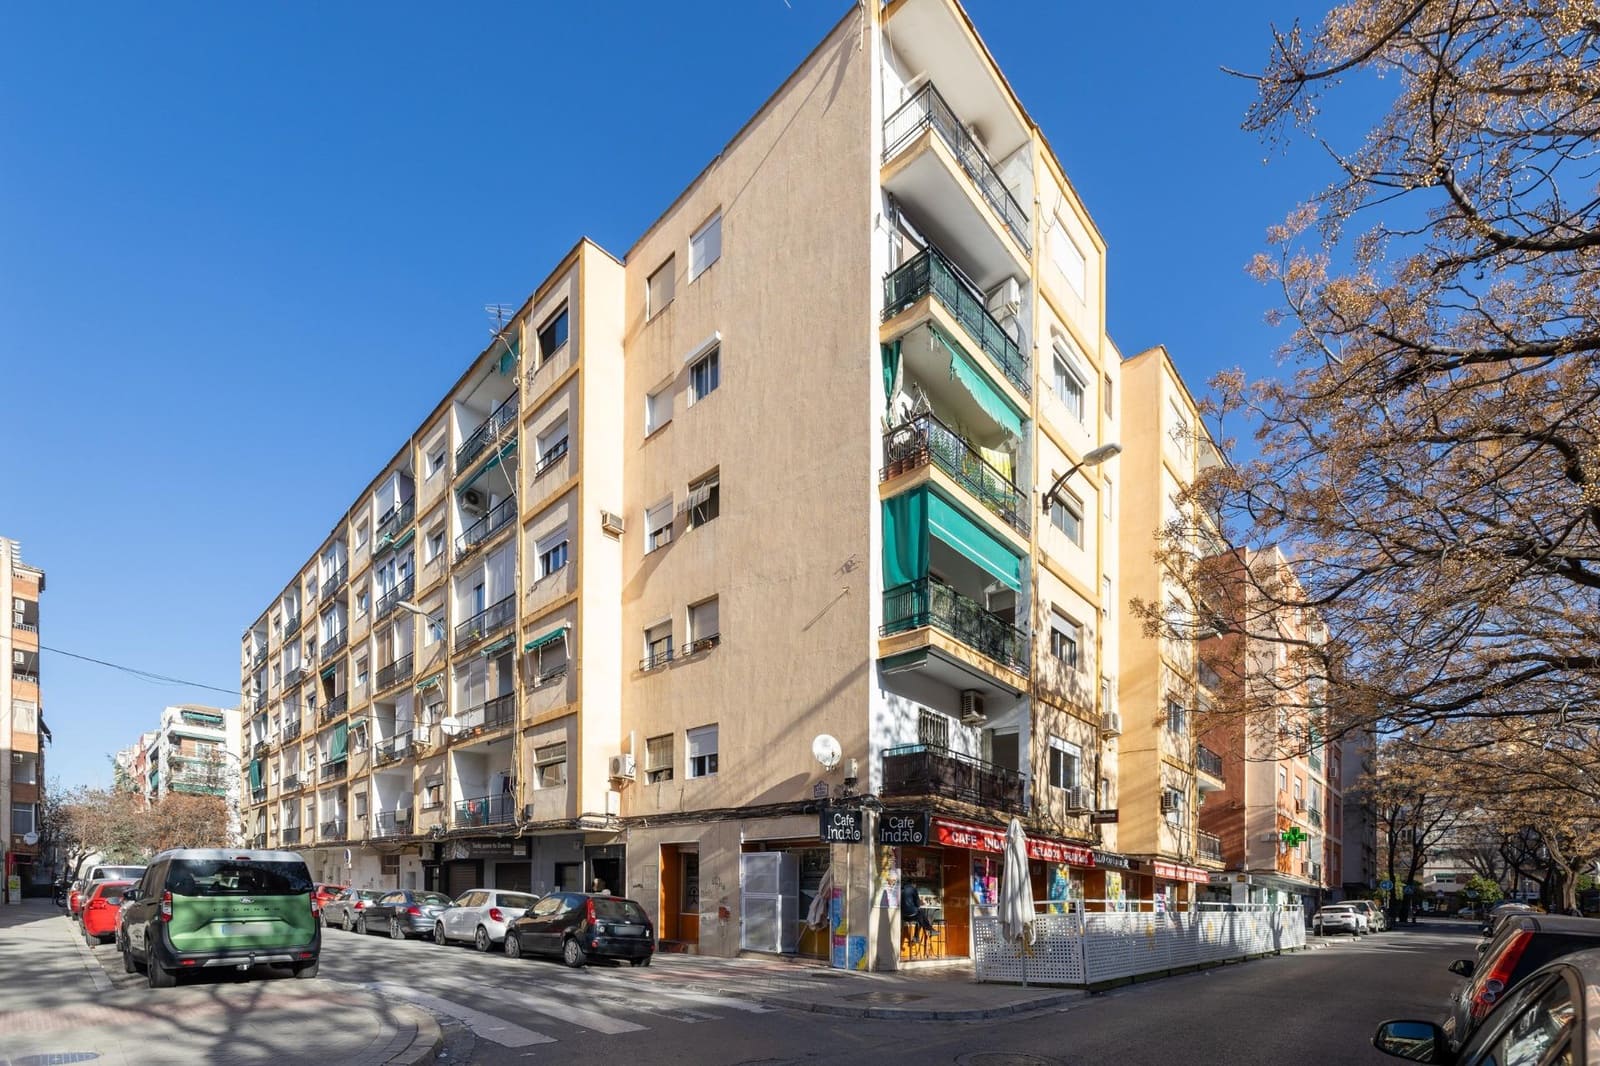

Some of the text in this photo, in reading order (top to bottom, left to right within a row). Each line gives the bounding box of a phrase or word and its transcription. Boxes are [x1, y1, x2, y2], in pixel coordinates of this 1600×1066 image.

[834, 813, 855, 826] Cafe
[889, 817, 915, 829] Cafe
[951, 831, 977, 846] CAFE
